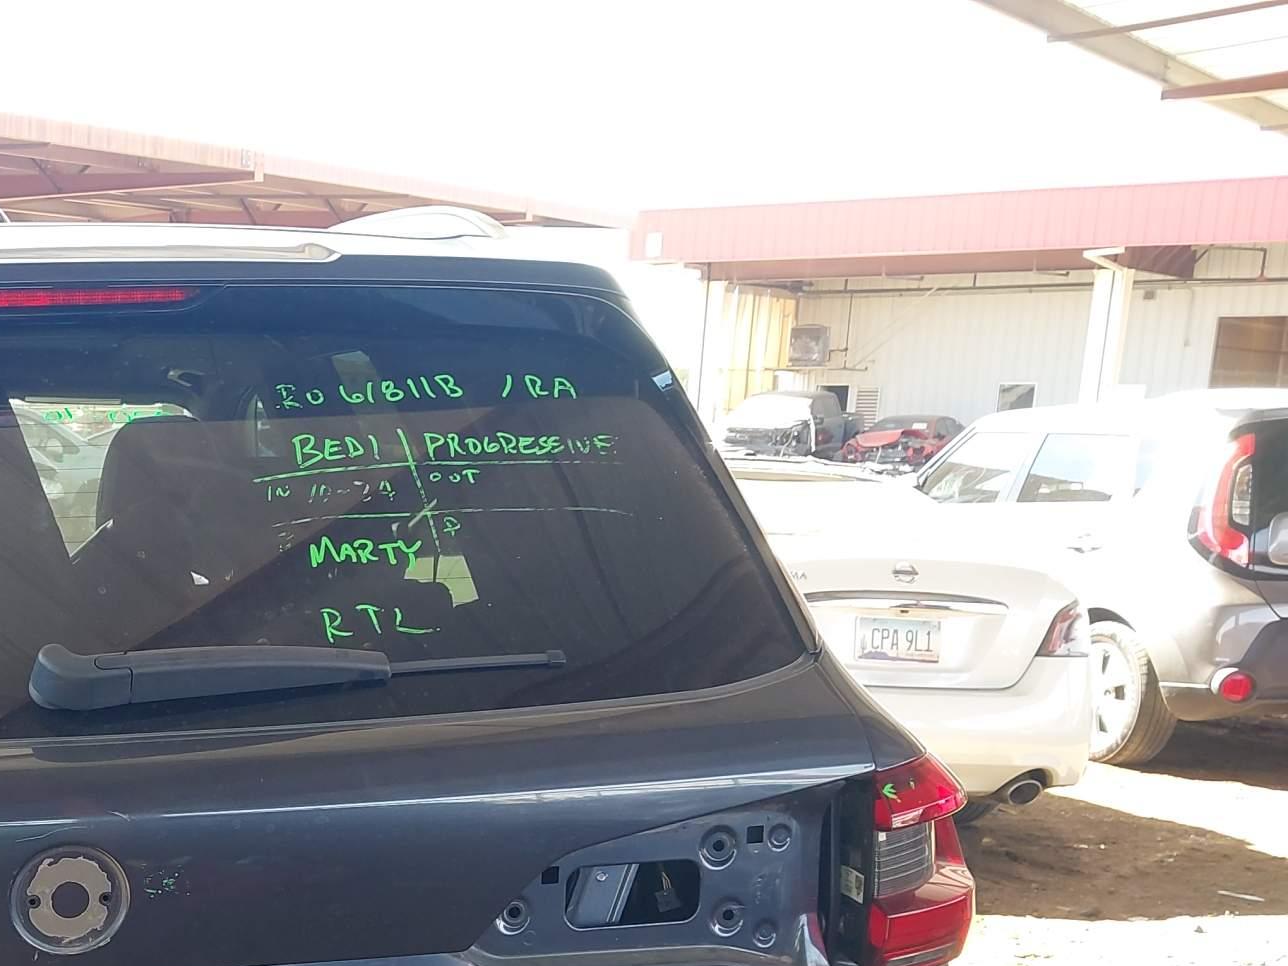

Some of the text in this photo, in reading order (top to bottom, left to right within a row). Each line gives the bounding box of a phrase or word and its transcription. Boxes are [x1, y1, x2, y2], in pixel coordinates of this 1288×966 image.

[309, 536, 422, 570] MARTY
[871, 627, 934, 653] CPA 9L1
